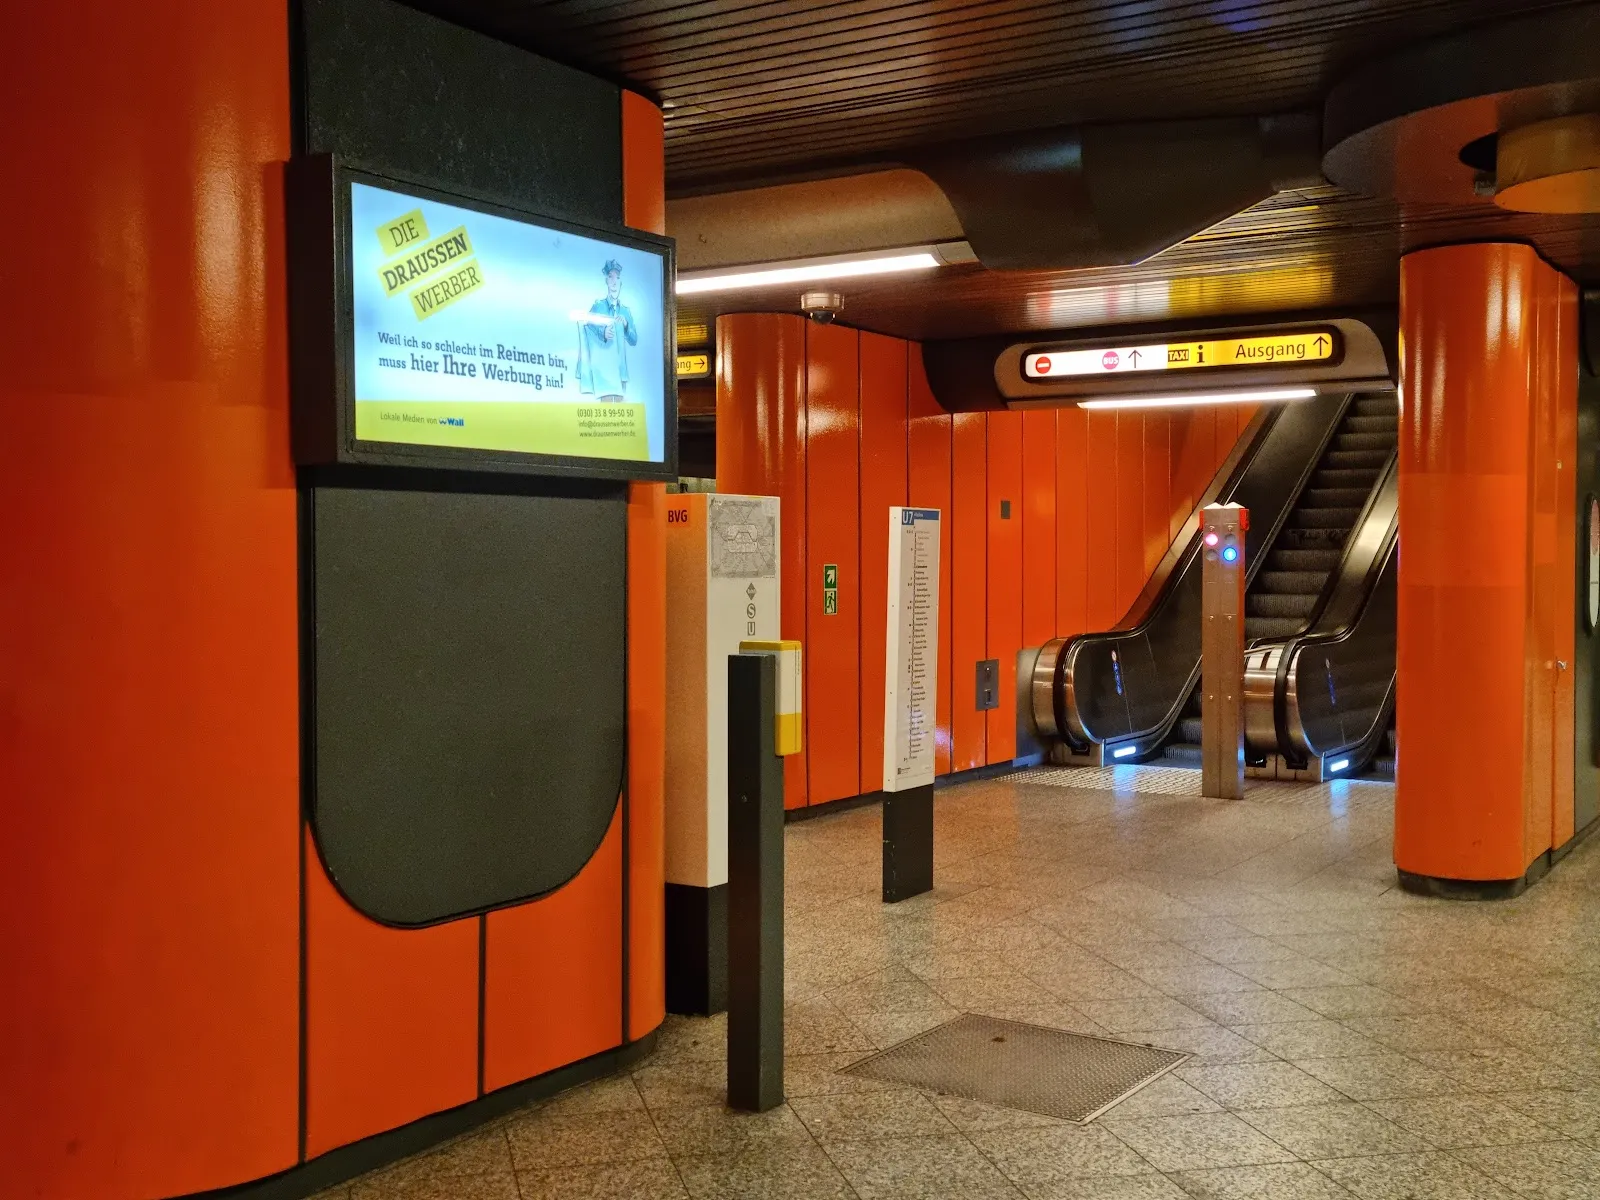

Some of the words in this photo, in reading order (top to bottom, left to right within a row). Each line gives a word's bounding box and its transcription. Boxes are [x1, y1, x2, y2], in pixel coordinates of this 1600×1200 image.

[389, 218, 420, 248] DIE
[383, 232, 468, 291] DRAUSSEN
[414, 266, 480, 313] WERBER
[377, 331, 401, 346] Weil
[403, 335, 418, 348] ich
[421, 340, 432, 350] so
[435, 340, 477, 356] schlecht
[479, 343, 494, 358] im
[496, 343, 546, 366] Reimen
[547, 352, 568, 371] bin,
[1103, 356, 1119, 365] BUS
[1168, 350, 1189, 361] TAXI
[1235, 343, 1306, 361] Ausgang
[378, 357, 407, 369] muss
[410, 352, 439, 373] hier
[442, 353, 477, 378] Ihre
[482, 362, 542, 391] Werbung
[545, 372, 564, 389] hin!
[380, 411, 400, 422] Lokale
[402, 413, 425, 424] Medien
[426, 417, 438, 425] von
[577, 408, 593, 418] (030)
[626, 409, 634, 417] 50
[668, 510, 688, 523] BVG
[902, 511, 914, 524] U7
